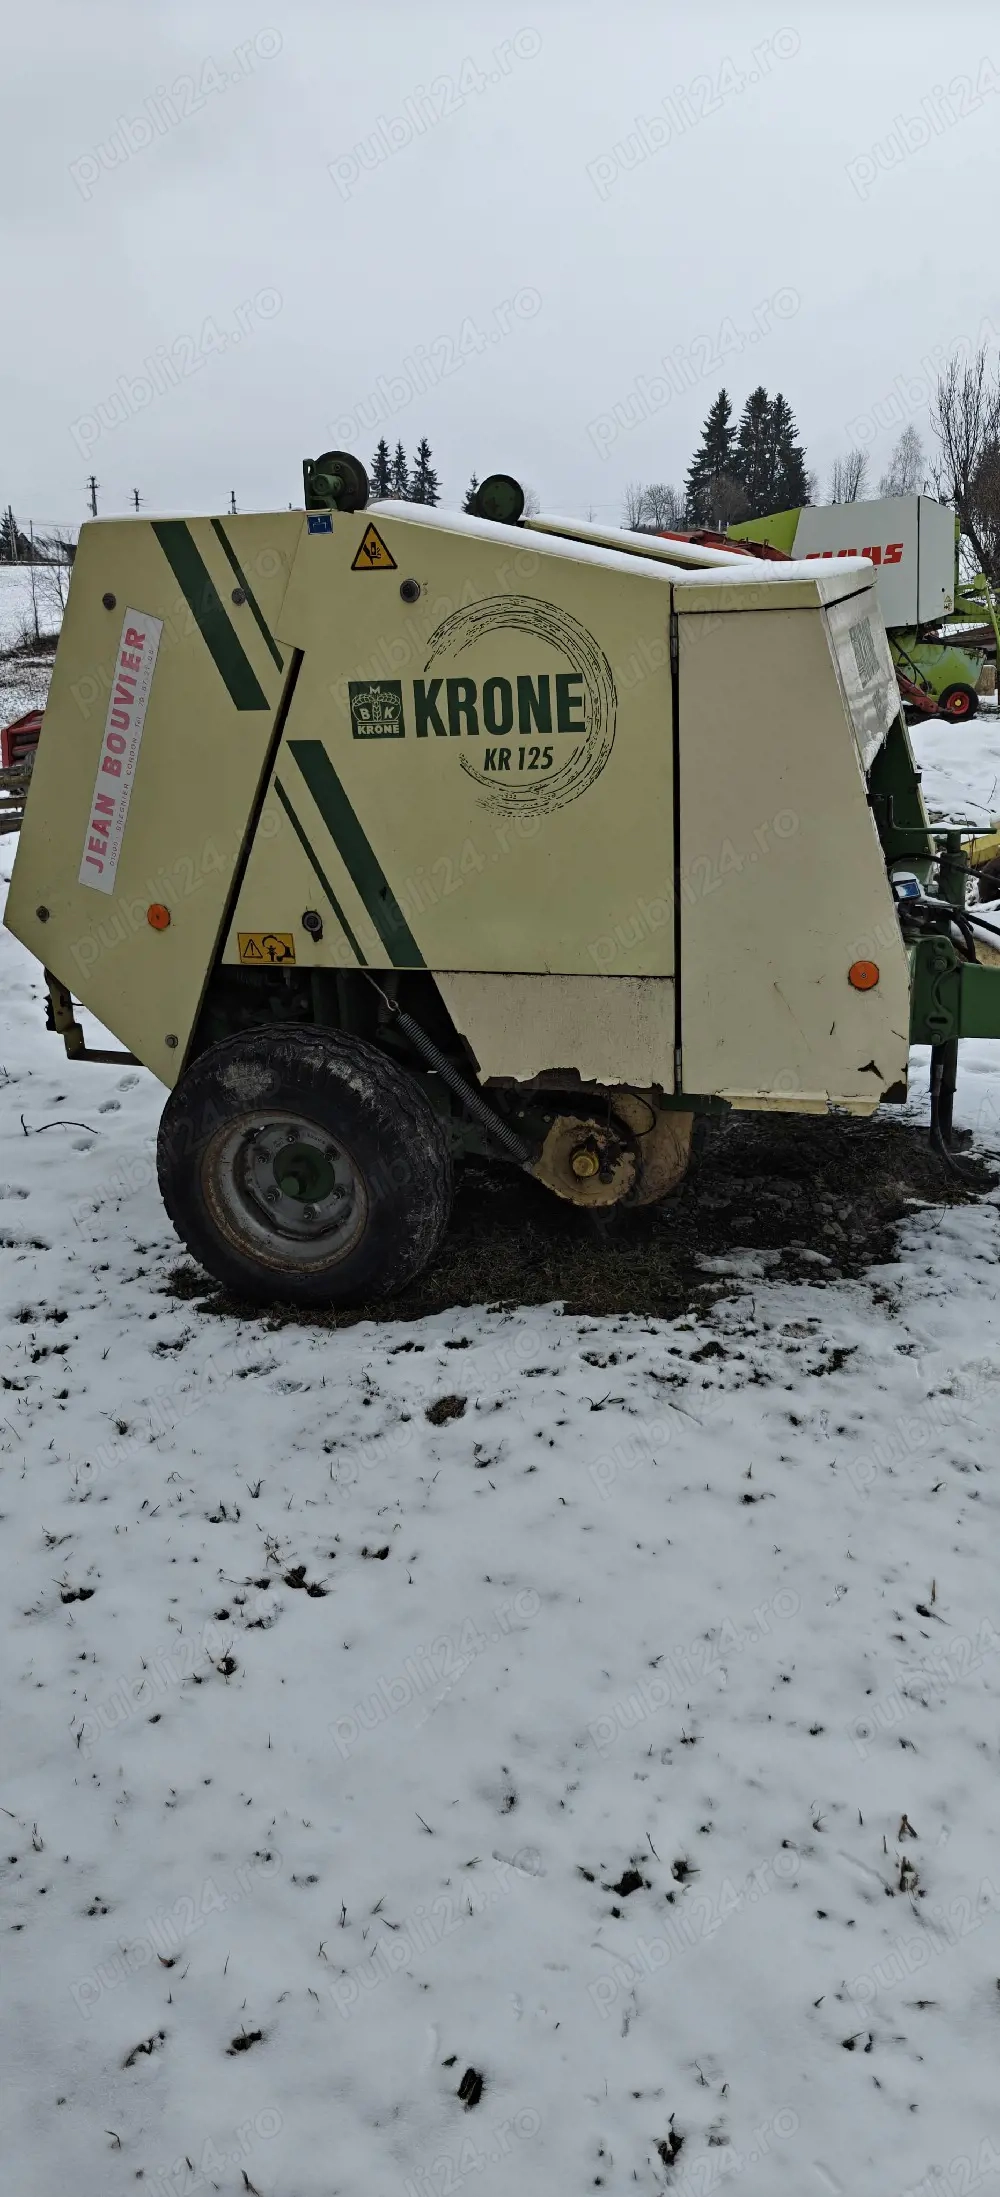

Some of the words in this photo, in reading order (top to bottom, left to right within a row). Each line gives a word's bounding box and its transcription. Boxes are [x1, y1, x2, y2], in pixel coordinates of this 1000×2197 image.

[369, 685, 381, 695] M
[359, 707, 371, 720] B
[384, 706, 395, 719] K
[413, 673, 586, 738] KRONE
[357, 724, 400, 735] KRONE
[86, 793, 116, 873] JEAN
[102, 628, 146, 777] BOUVIER
[483, 746, 512, 771] KR
[517, 746, 554, 771] 125
